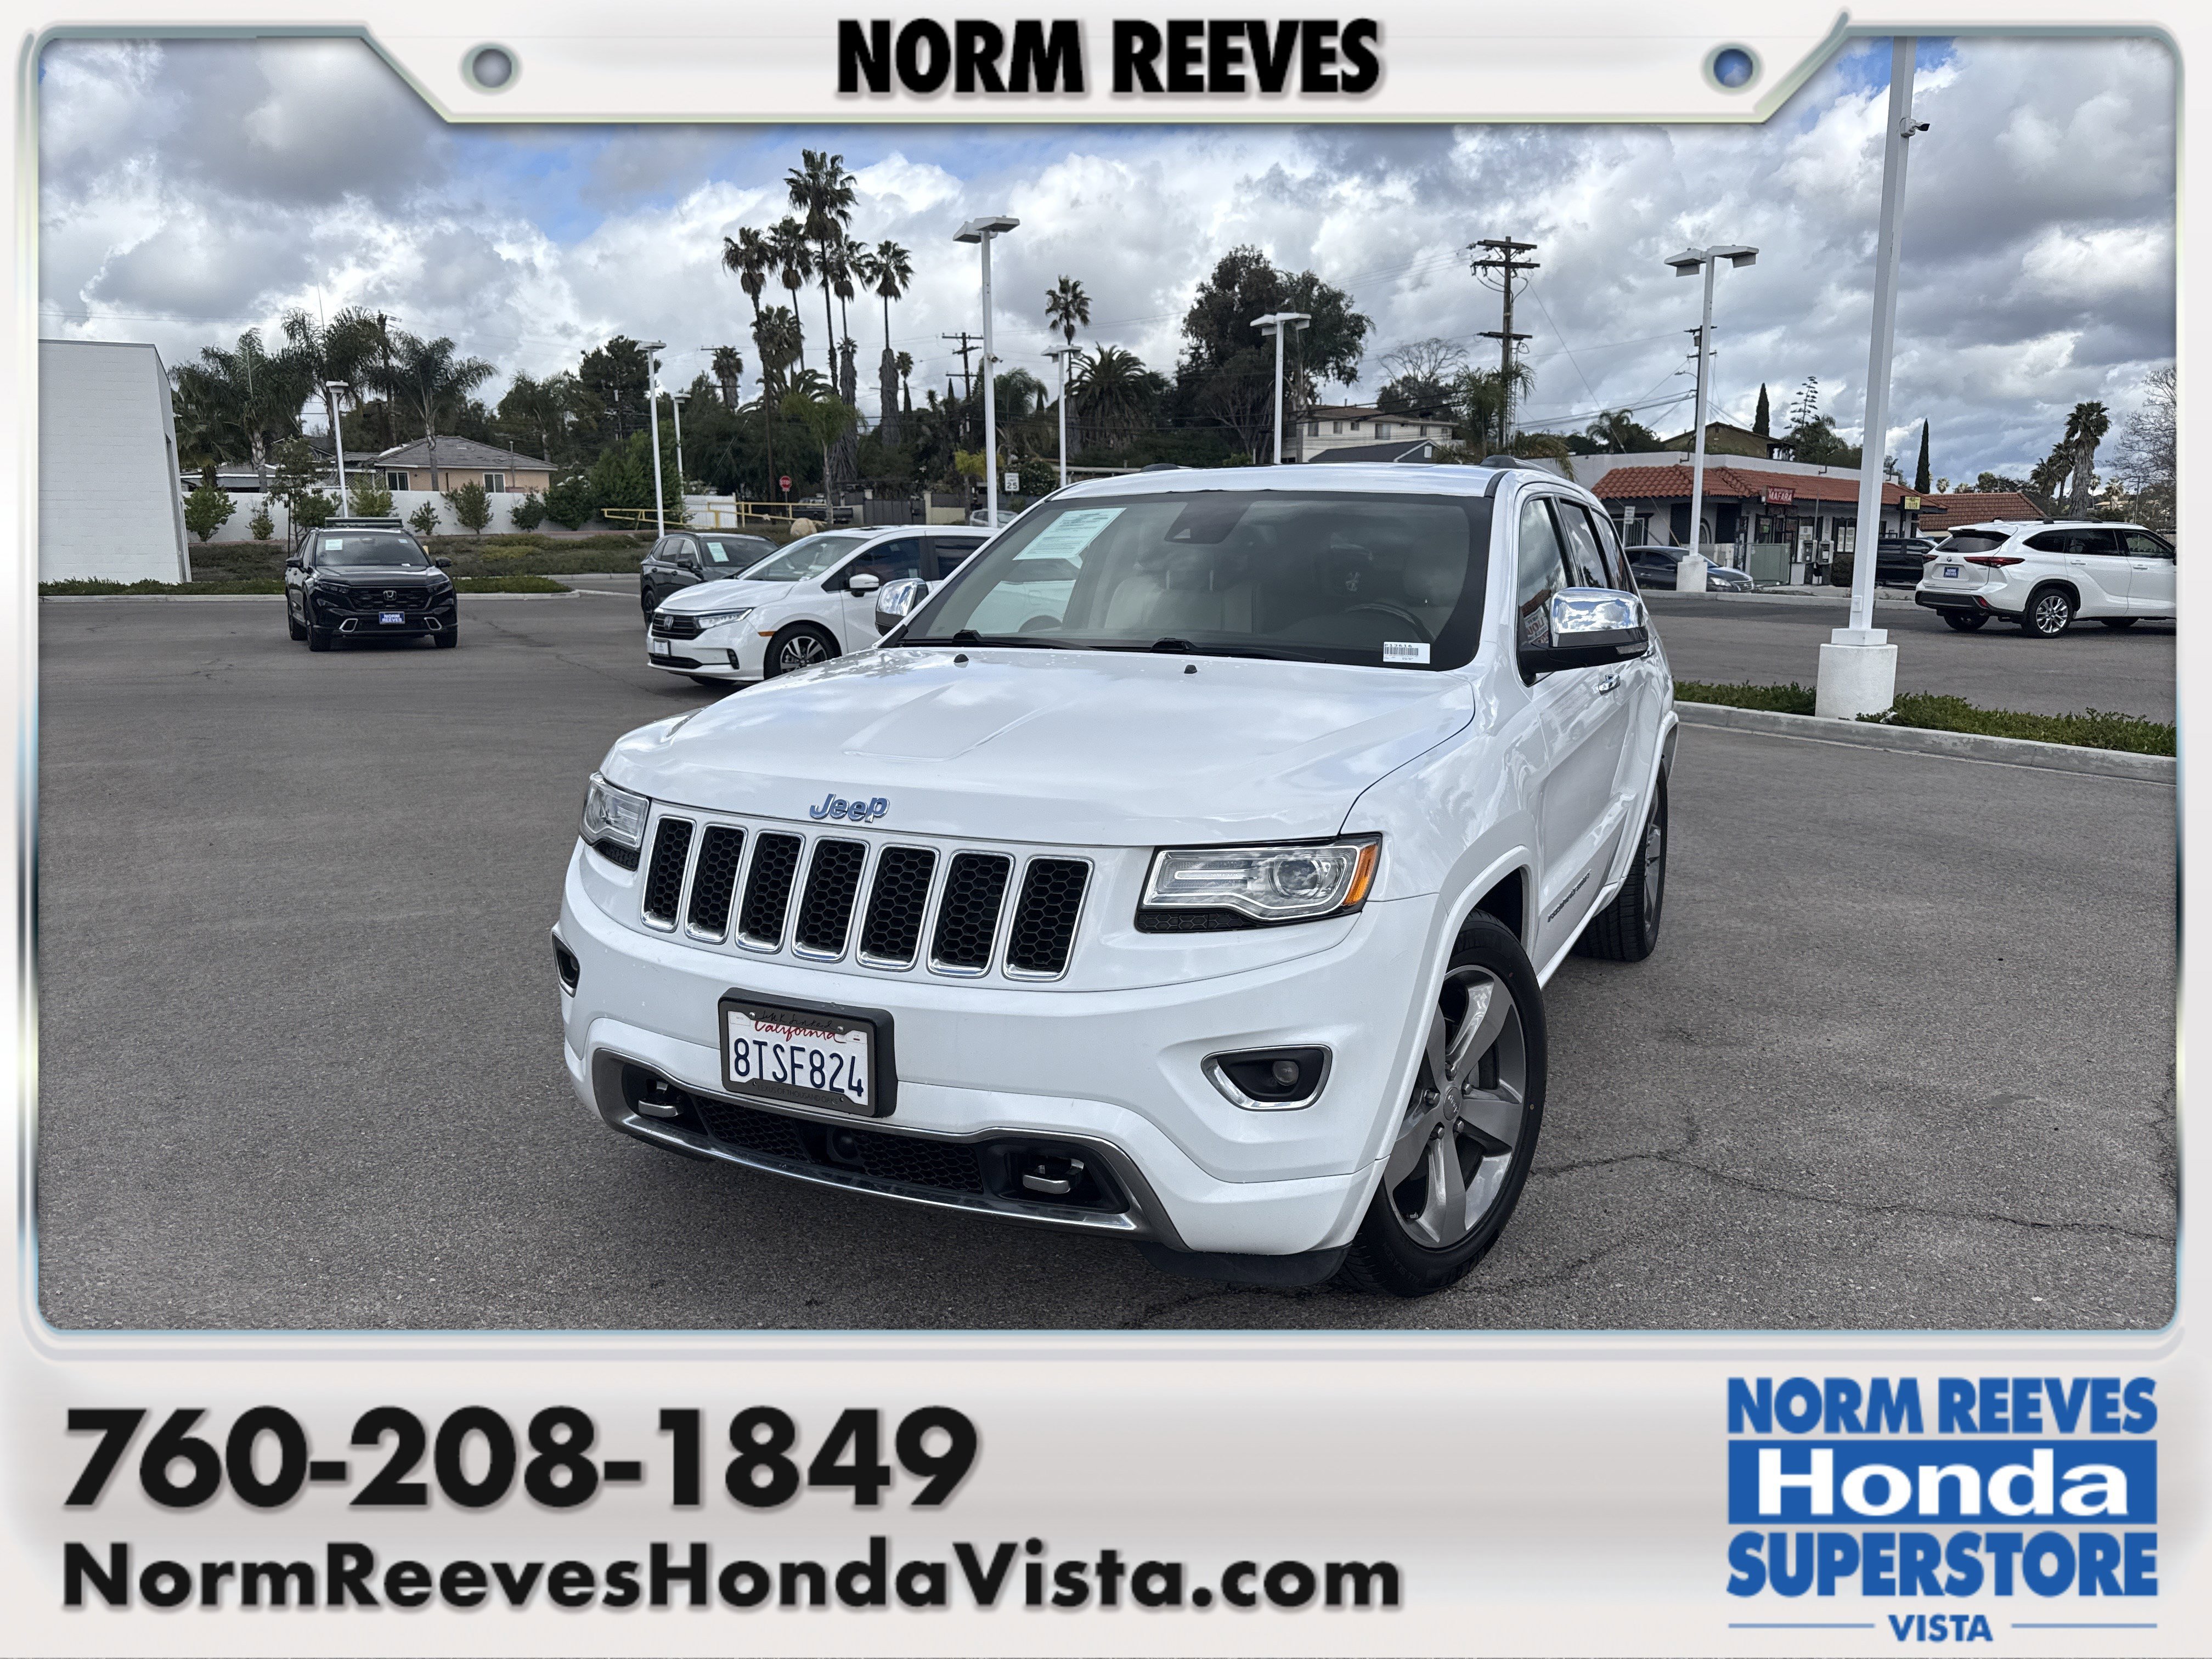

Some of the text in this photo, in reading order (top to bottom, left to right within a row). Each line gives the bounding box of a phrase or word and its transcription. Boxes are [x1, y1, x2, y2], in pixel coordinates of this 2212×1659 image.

[810, 793, 890, 823] Jeep
[754, 1020, 847, 1043] California
[734, 1037, 864, 1097] 8TSF824
[758, 1085, 776, 1093] LEXUS
[786, 1090, 821, 1102] THOUSAND
